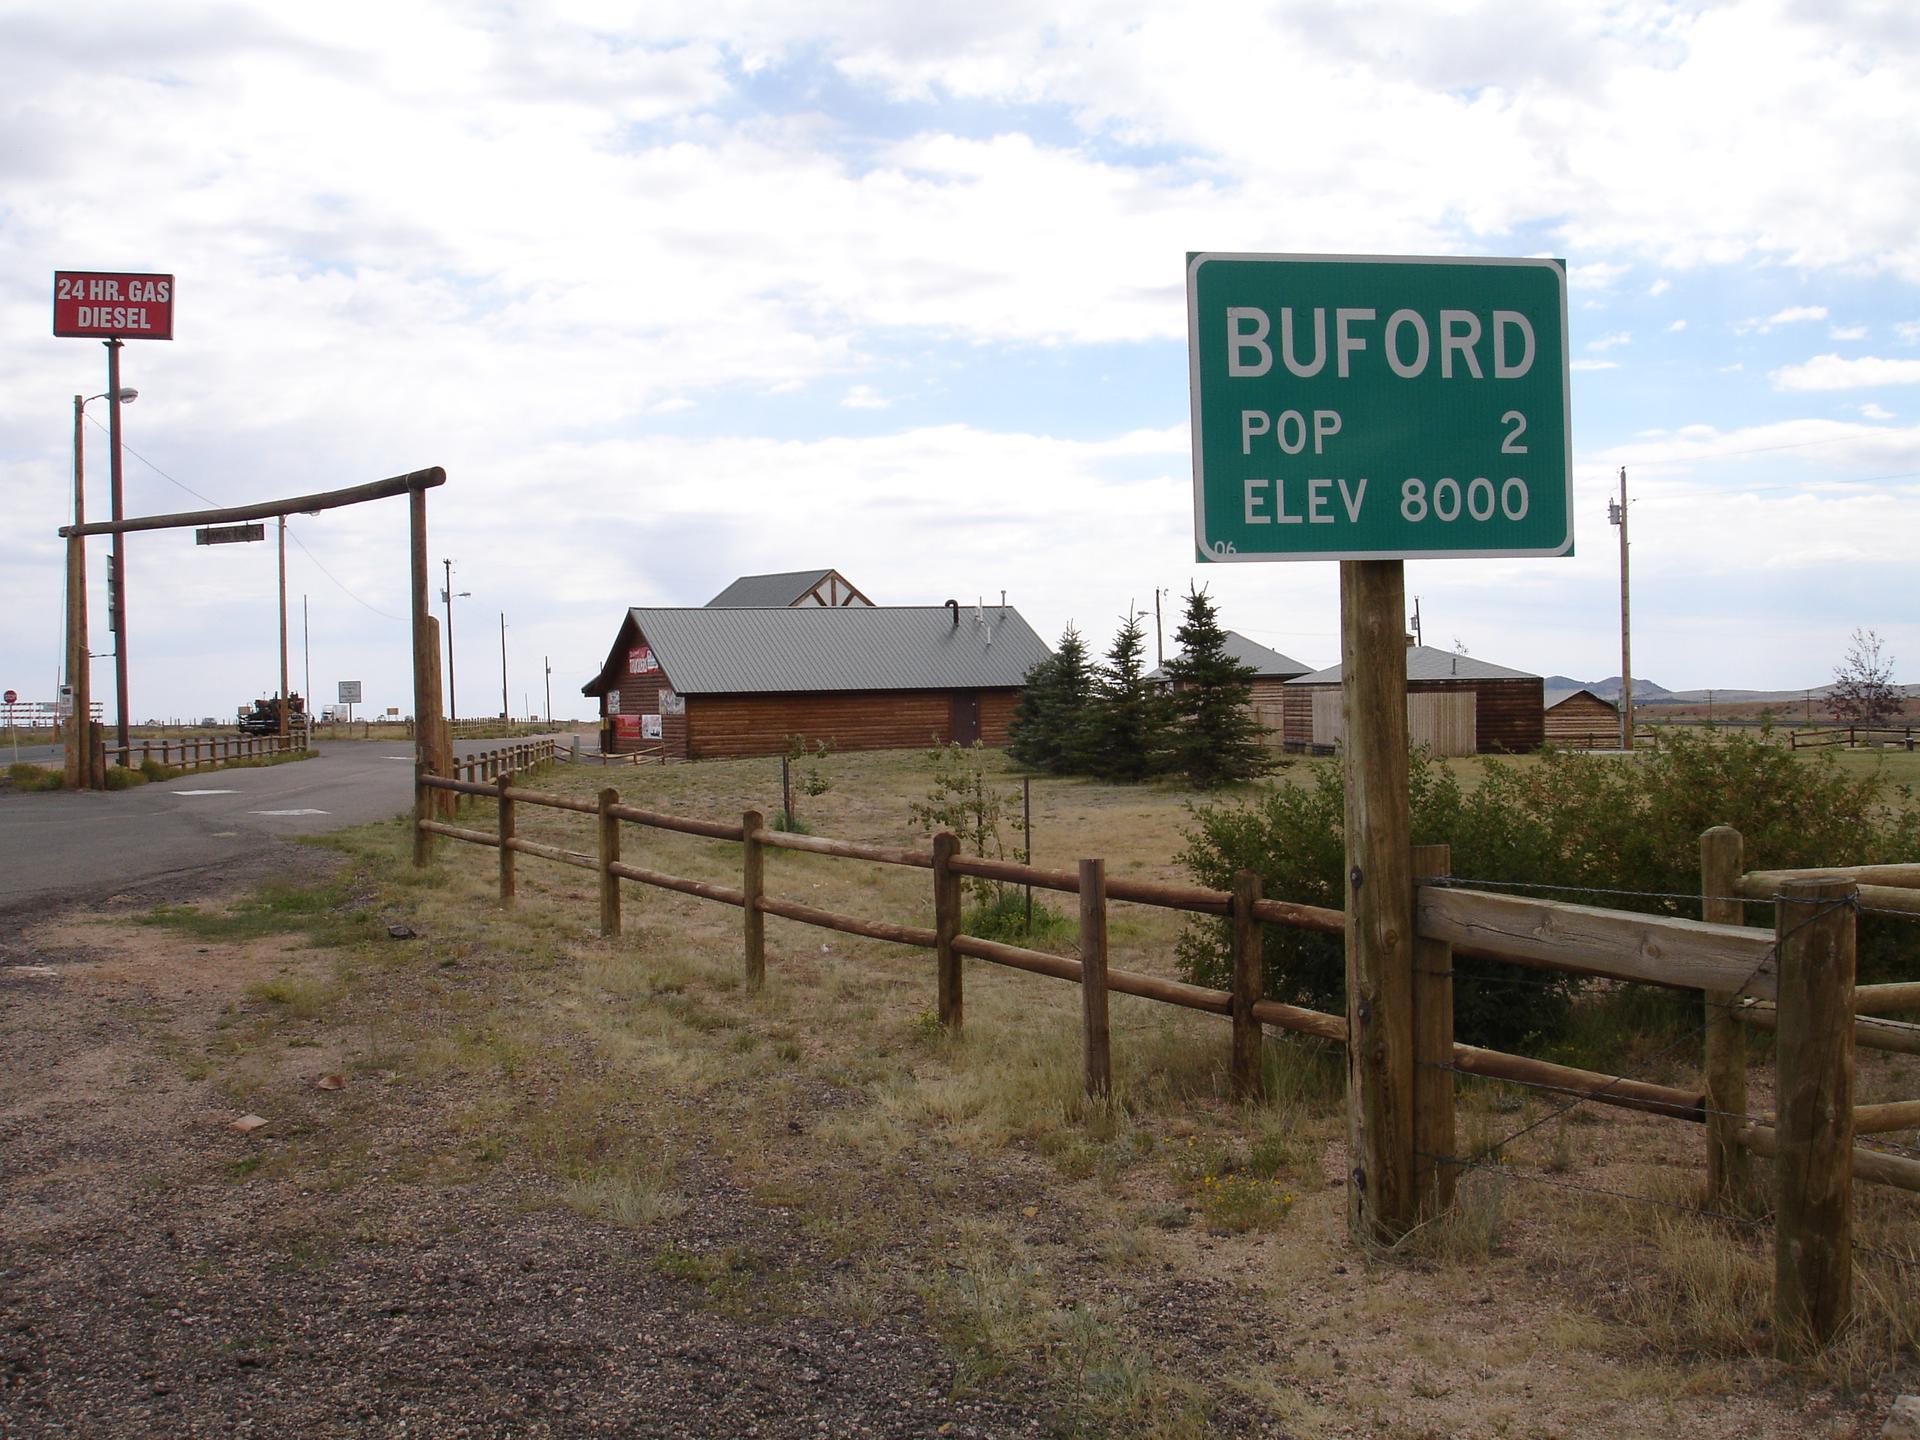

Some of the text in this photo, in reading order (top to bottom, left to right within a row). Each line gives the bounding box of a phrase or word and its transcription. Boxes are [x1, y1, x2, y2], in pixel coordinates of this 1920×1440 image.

[58, 279, 170, 303] 24 HR. GAS
[78, 306, 151, 329] DIESEL
[1226, 306, 1536, 379] BUFORD
[1241, 409, 1528, 454] POP 2
[1244, 477, 1529, 524] ELEV 8000
[1214, 541, 1237, 556] 06
